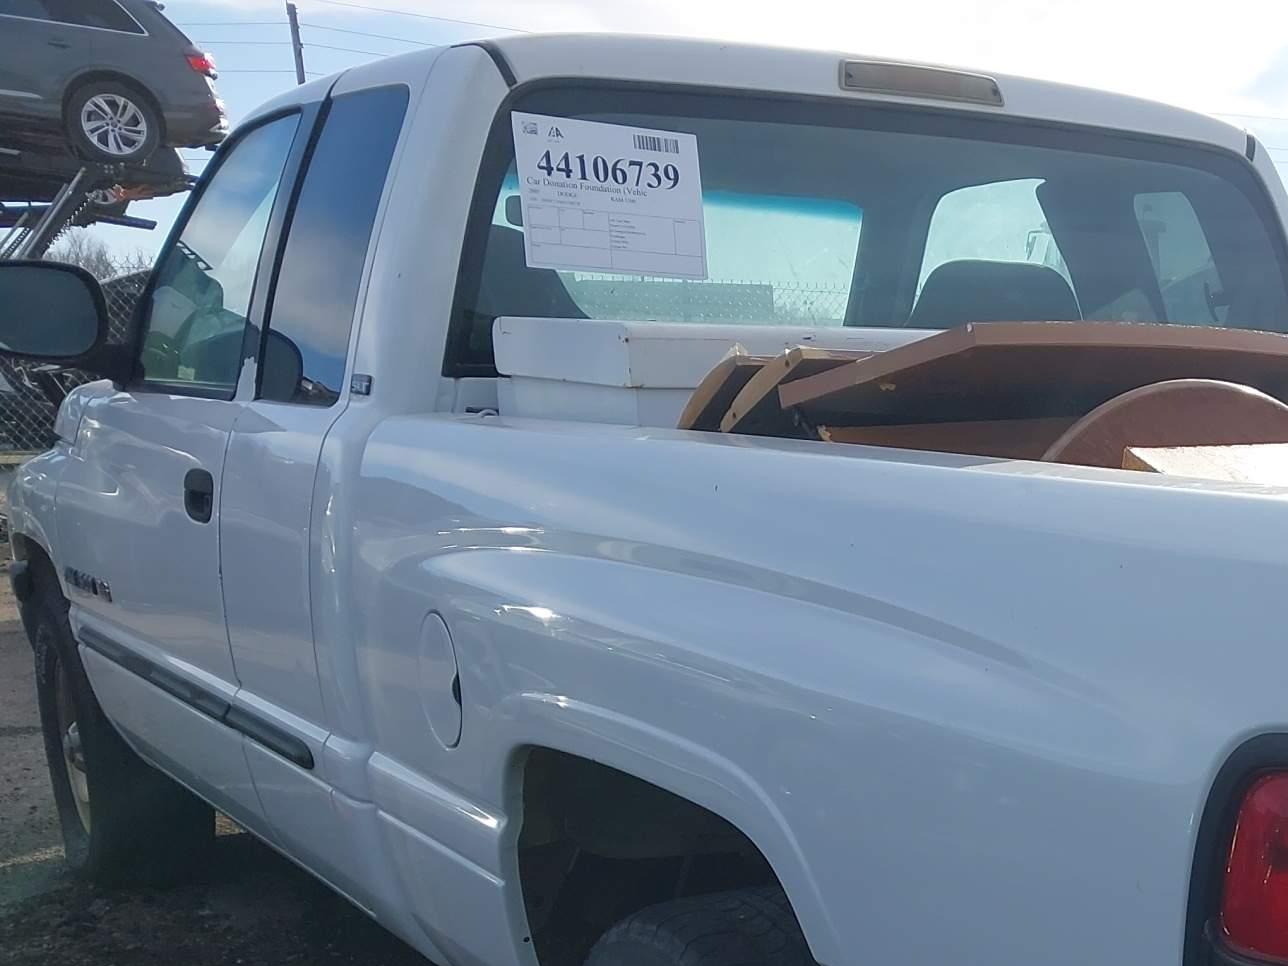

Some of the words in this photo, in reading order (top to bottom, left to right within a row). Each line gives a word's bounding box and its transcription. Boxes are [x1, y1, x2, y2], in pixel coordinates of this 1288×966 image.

[536, 149, 680, 190] 44106739
[526, 176, 541, 185] Car
[543, 178, 578, 189] Donation
[580, 181, 621, 194] Foundation
